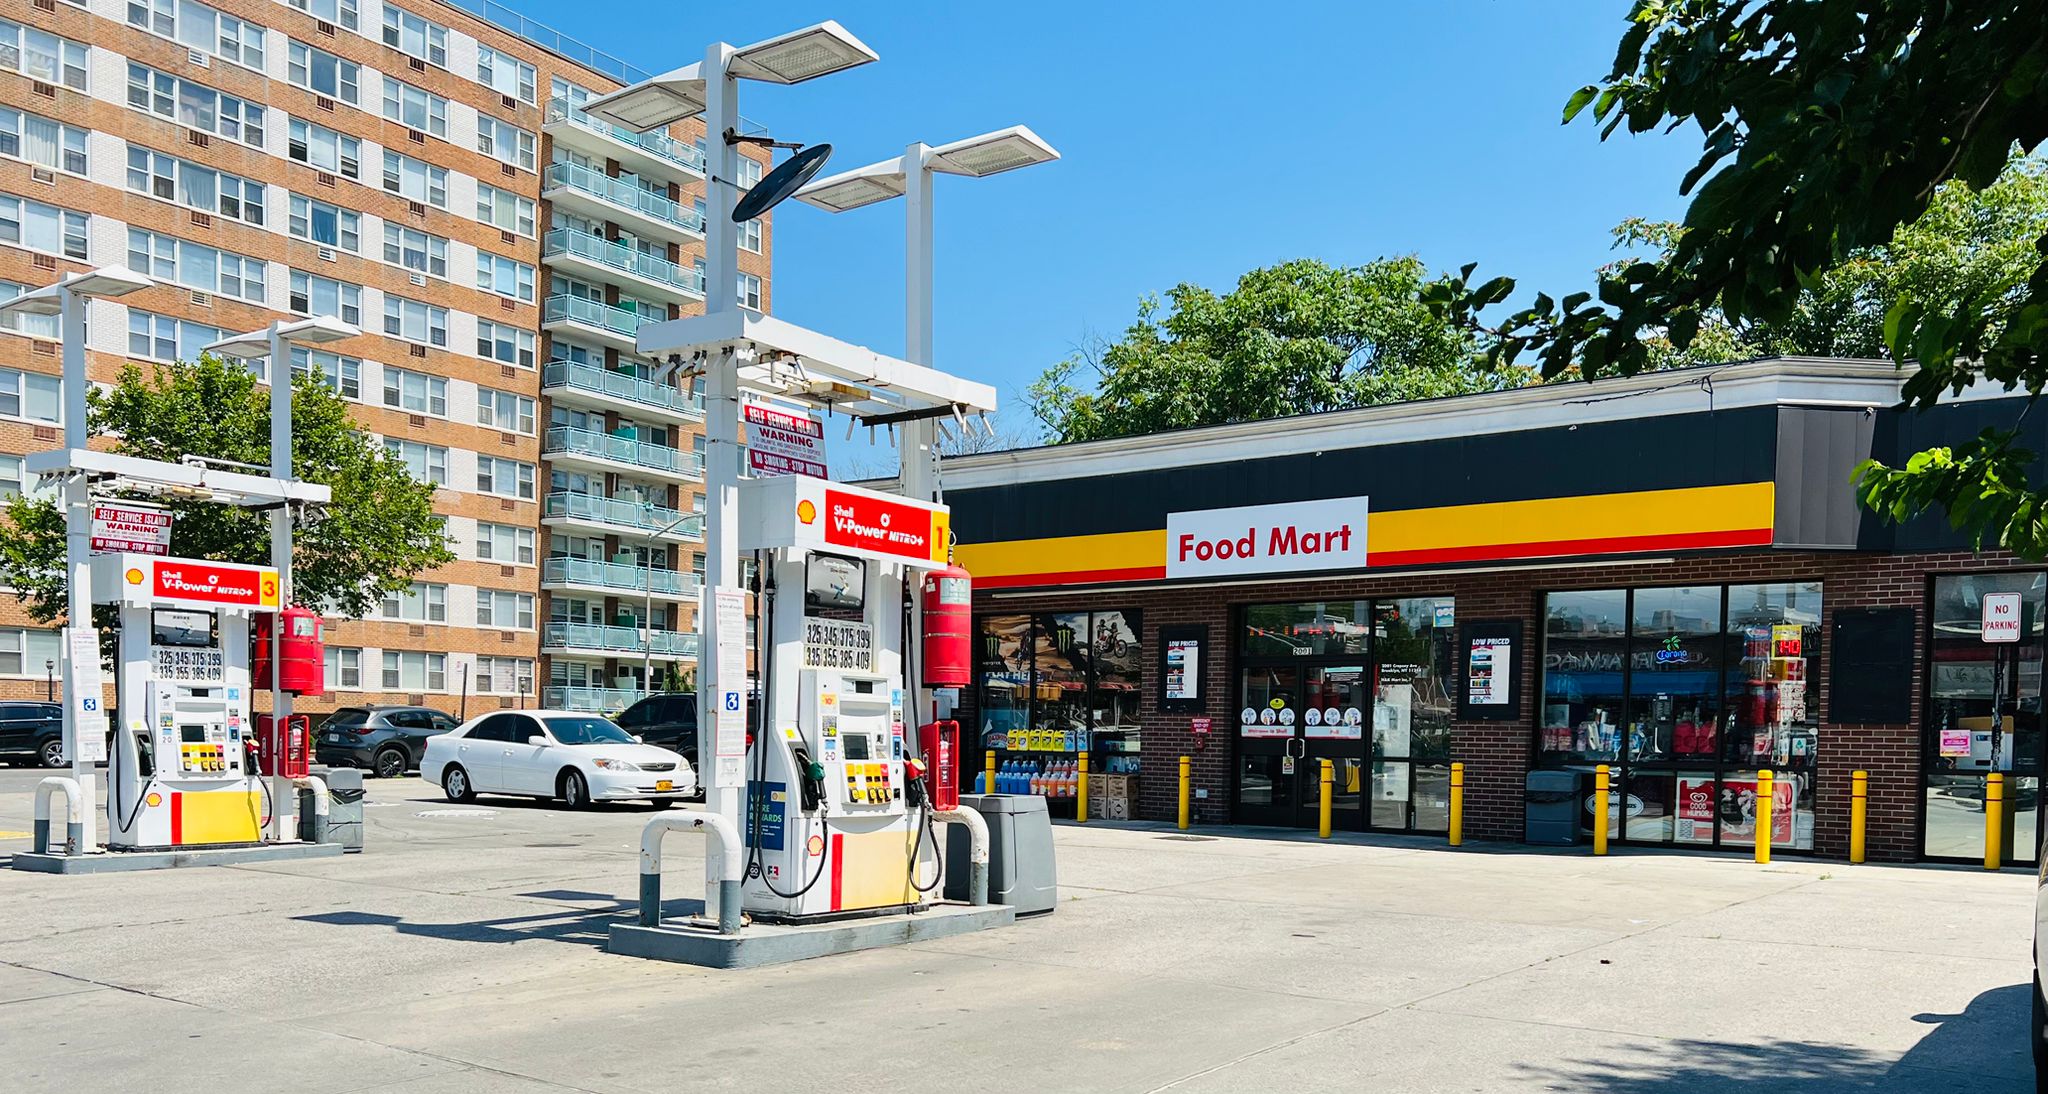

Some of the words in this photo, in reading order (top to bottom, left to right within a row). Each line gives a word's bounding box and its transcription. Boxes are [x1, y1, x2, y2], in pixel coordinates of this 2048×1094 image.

[749, 407, 765, 424] SELF
[766, 411, 795, 432] SERVICE
[795, 418, 819, 437] ISLAND
[759, 427, 813, 448] WARNING
[754, 453, 763, 464] NO
[764, 455, 789, 470] SMOKING
[792, 460, 805, 473] STOP
[806, 464, 823, 477] MOTOR
[99, 509, 115, 520] SELF
[116, 512, 143, 523] SERVICE
[144, 515, 167, 526] ISLAND
[833, 504, 854, 518] Shell
[106, 522, 159, 533] WARNING
[834, 516, 885, 539] V-Power
[888, 531, 924, 546] NITRO+
[936, 526, 943, 549] 1
[1179, 527, 1255, 562] Food
[1268, 524, 1351, 556] Mart
[105, 540, 129, 550] SMOKING
[131, 543, 145, 551] STOP
[146, 545, 163, 553] MOTOR
[161, 570, 182, 579] Shell
[162, 579, 213, 593] V-Power
[217, 587, 253, 596] NITRO+
[263, 581, 275, 597] 3
[1995, 605, 2009, 614] NO
[1985, 620, 2018, 631] PARKING
[807, 624, 821, 644] 325
[824, 626, 838, 647] 345
[840, 628, 854, 648] 375
[856, 629, 870, 649] 399
[159, 650, 173, 664] 325
[175, 652, 189, 665] 345
[191, 652, 205, 665] 375
[207, 653, 221, 666] 399
[807, 646, 820, 667] 335
[824, 648, 837, 668] 355
[840, 650, 853, 669] 385
[856, 651, 870, 670] 409
[159, 665, 173, 679] 335
[175, 666, 189, 680] 355
[191, 667, 205, 680] 385
[207, 667, 221, 680] 409
[1687, 809, 1711, 817] HUMOR
[1690, 802, 1707, 810] GOOD
